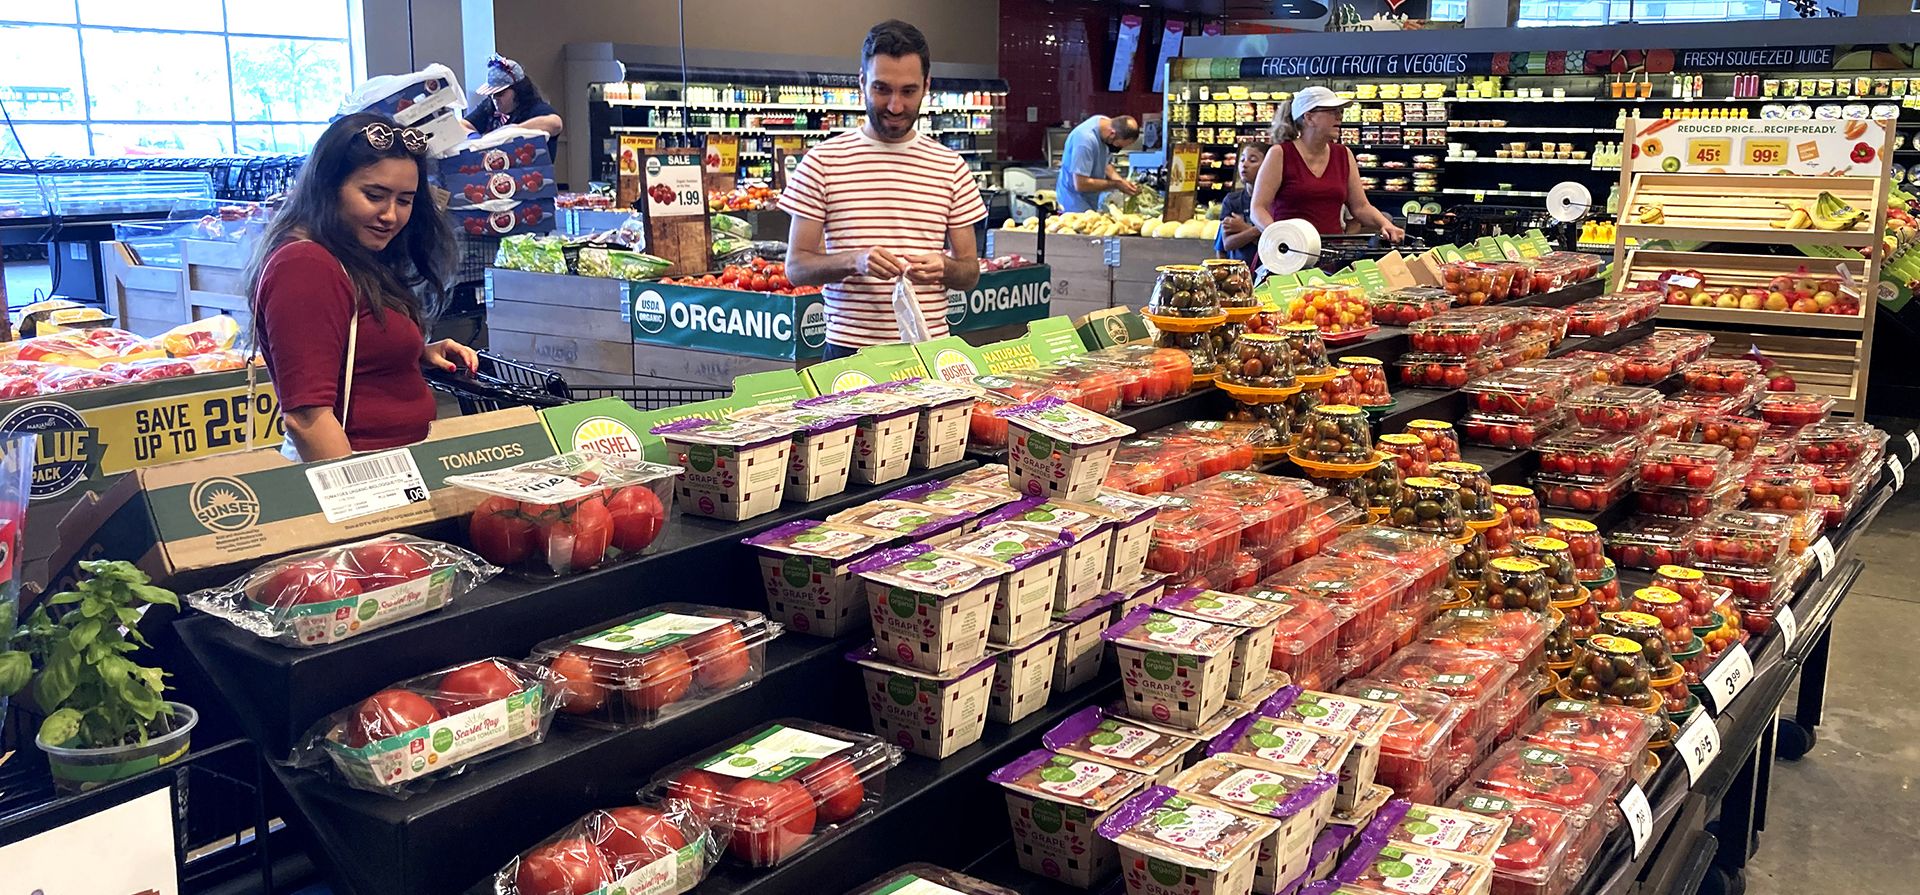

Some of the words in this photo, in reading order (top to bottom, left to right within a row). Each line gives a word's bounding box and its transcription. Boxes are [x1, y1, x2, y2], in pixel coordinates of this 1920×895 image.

[1261, 57, 1307, 75] FRESH
[1310, 56, 1340, 74] CUT
[1342, 55, 1384, 74] FRUIT
[1387, 54, 1398, 74] &
[1403, 53, 1468, 74] VEGGIES
[1684, 51, 1729, 66] FRESH
[1727, 49, 1792, 66] SQUEEZED
[1796, 48, 1831, 65] JUICE
[1677, 125, 1723, 133] REDUCED
[638, 138, 654, 146] PRICE
[667, 155, 691, 165] SALE
[1696, 148, 1721, 162] 45¢
[1752, 149, 1779, 163] 99¢
[677, 190, 700, 206] 1.99
[641, 300, 660, 311] USDA
[970, 281, 1051, 314] ORGANIC
[639, 312, 663, 324] ORGANIC
[670, 301, 793, 341] ORGANIC
[806, 311, 824, 323] USDA
[982, 343, 1033, 363] NATURALLY
[890, 364, 927, 382] NATUR
[941, 363, 975, 382] BUSHEL
[136, 403, 190, 434] SAVE
[203, 393, 285, 448] 25%
[7, 431, 89, 473] VLUE
[134, 434, 162, 461] UP
[169, 428, 197, 454] TO
[438, 443, 525, 472] TOMATOES
[1023, 456, 1051, 473] GRAPE
[689, 473, 718, 485] GRAPE
[410, 487, 425, 501] 06
[197, 501, 258, 523] SUNSET
[782, 588, 814, 601] GRAPE
[888, 617, 919, 633] GRAPE
[1146, 662, 1172, 672] organic
[1142, 680, 1176, 693] GRAPE
[887, 704, 919, 721] GRAPE
[454, 721, 483, 741] Scarlet
[484, 715, 501, 730] Ray
[477, 725, 506, 741] TOMATOES
[1031, 831, 1065, 849] GRAPE
